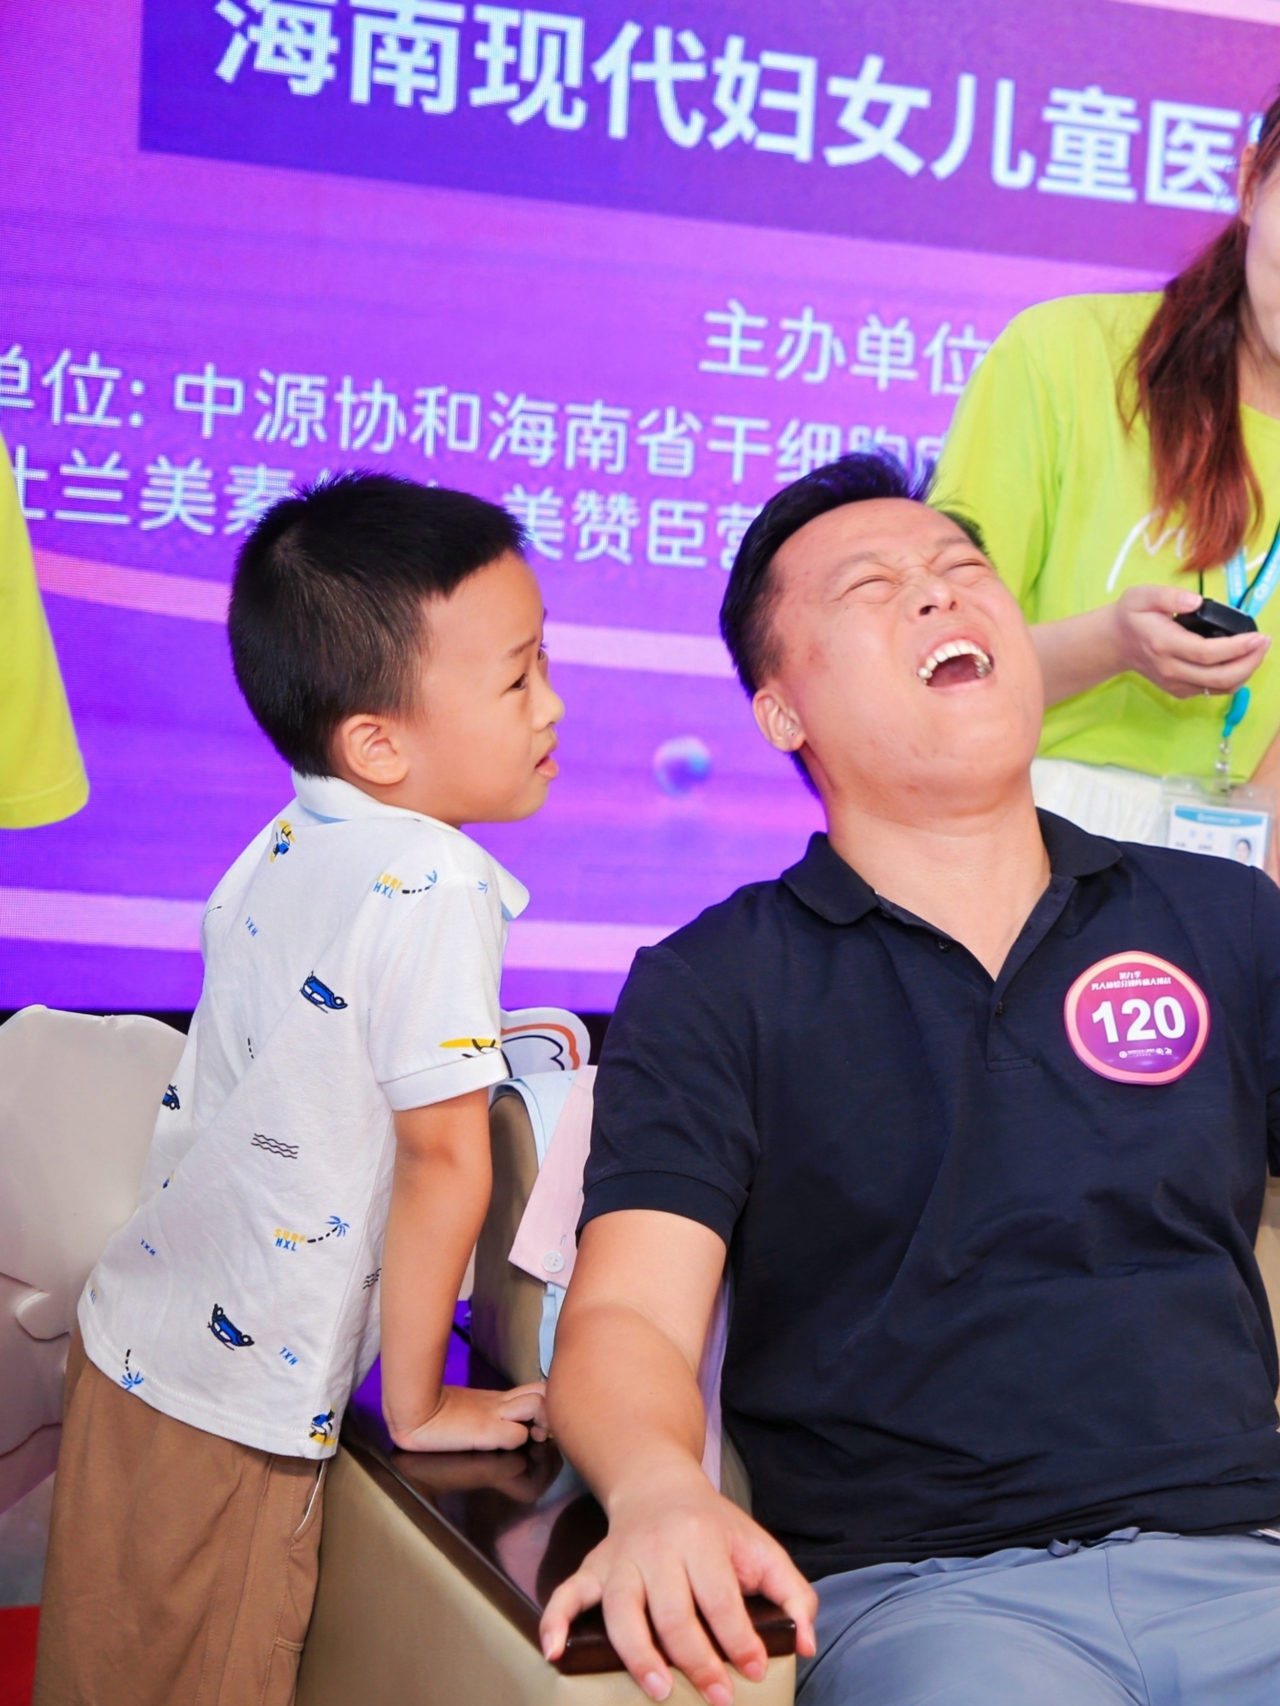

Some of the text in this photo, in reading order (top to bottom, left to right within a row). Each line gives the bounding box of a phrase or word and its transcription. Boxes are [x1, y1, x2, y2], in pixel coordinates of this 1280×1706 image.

[699, 299, 992, 397] 主办单位
[1091, 996, 1186, 1043] 120
